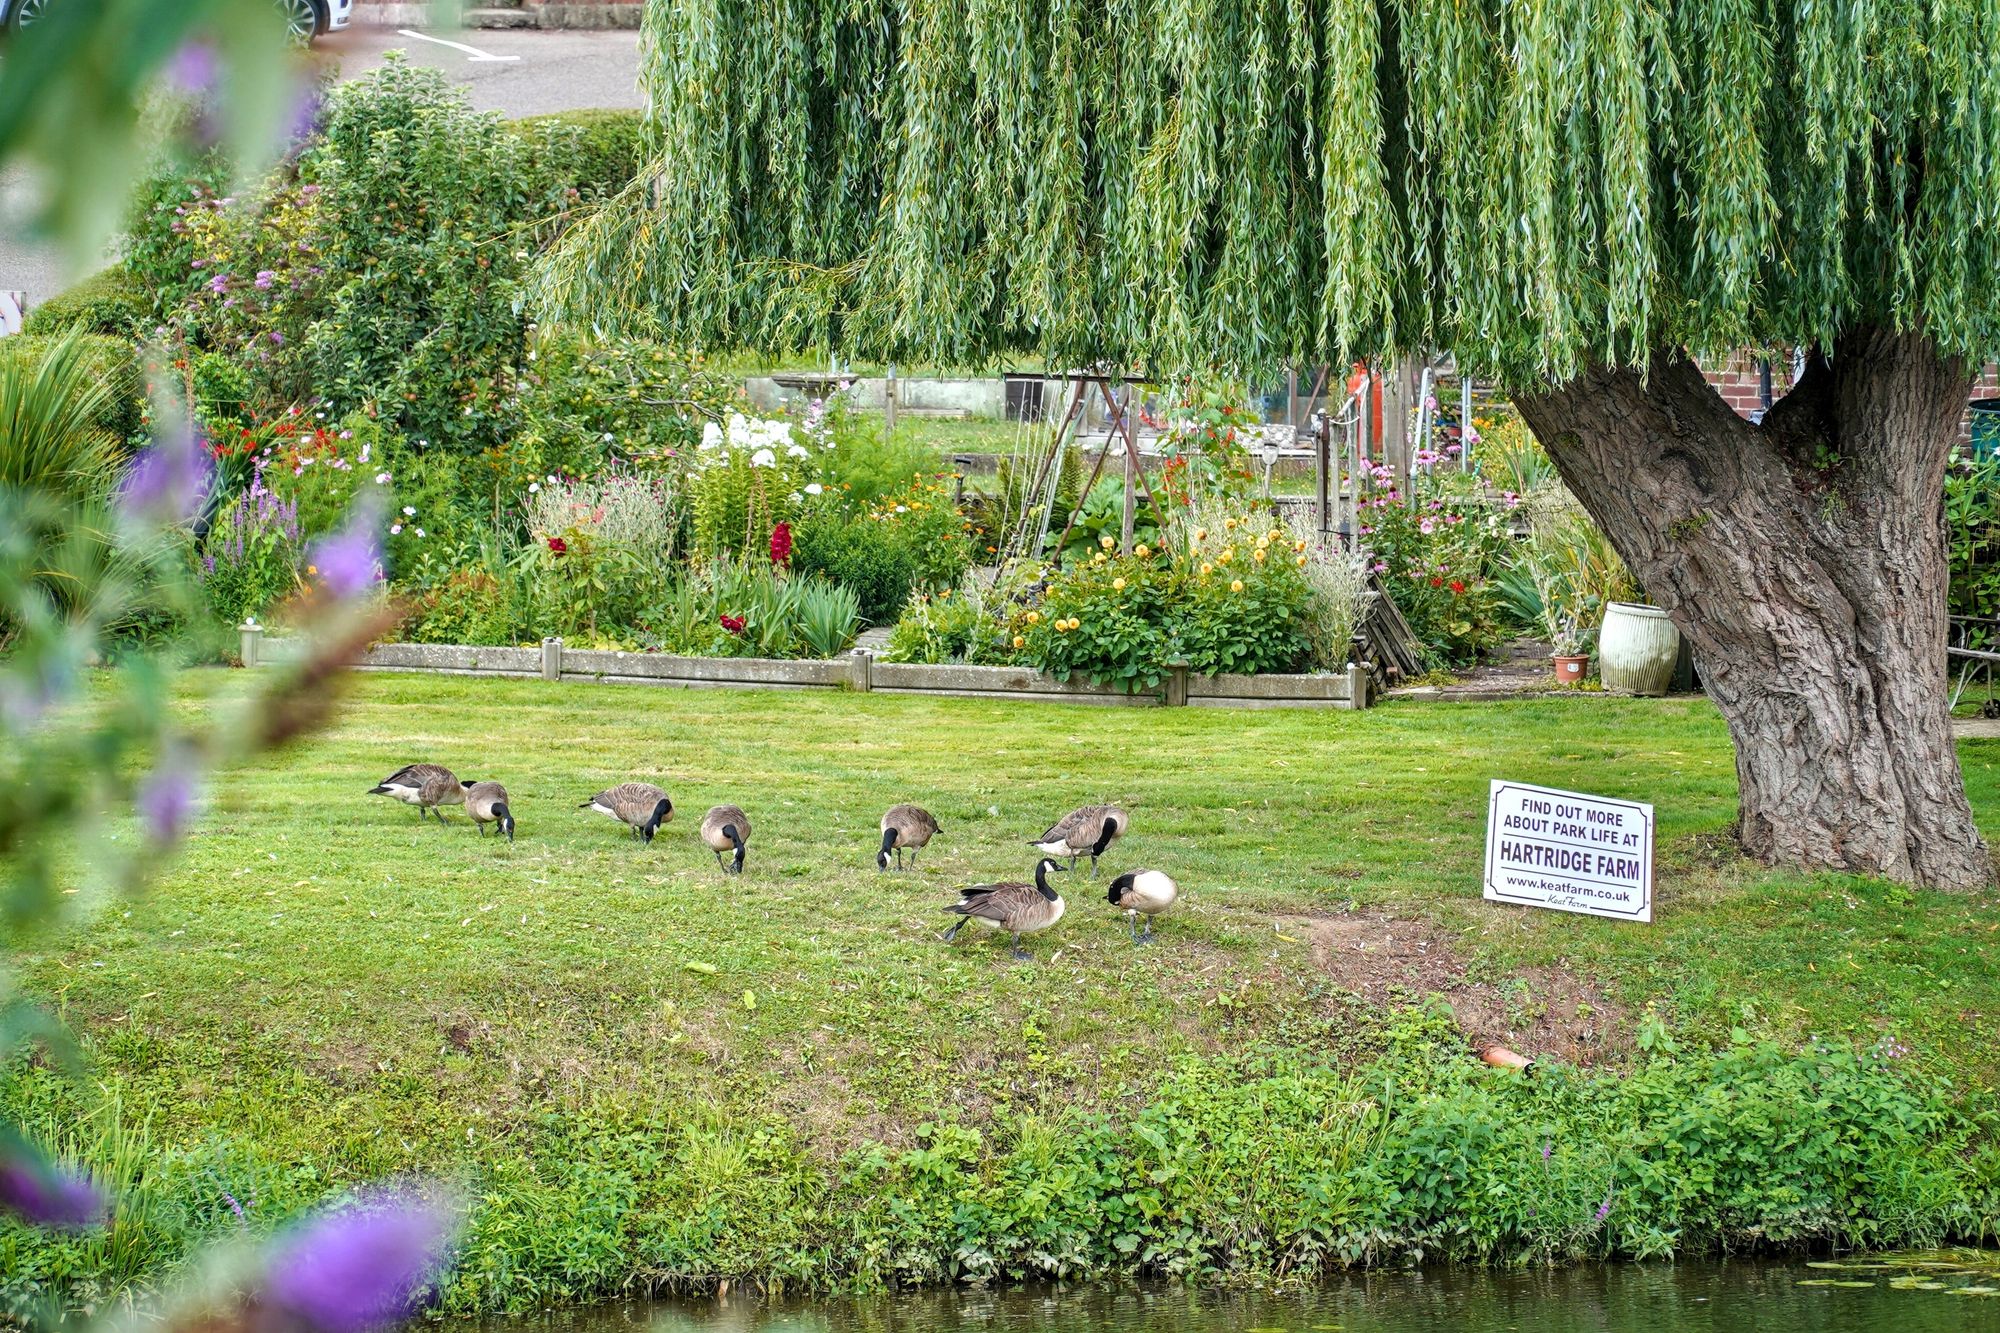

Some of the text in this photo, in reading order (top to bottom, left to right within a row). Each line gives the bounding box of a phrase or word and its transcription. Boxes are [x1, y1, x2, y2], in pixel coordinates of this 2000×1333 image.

[1521, 798, 1623, 827] FIND OUT MORE
[1503, 814, 1639, 848] ABOUT PARK LIFE AT
[1500, 840, 1640, 881] HARTRIDGE FARM
[1506, 875, 1630, 902] www.keatfarm.co.uk
[1547, 893, 1567, 906] Keat
